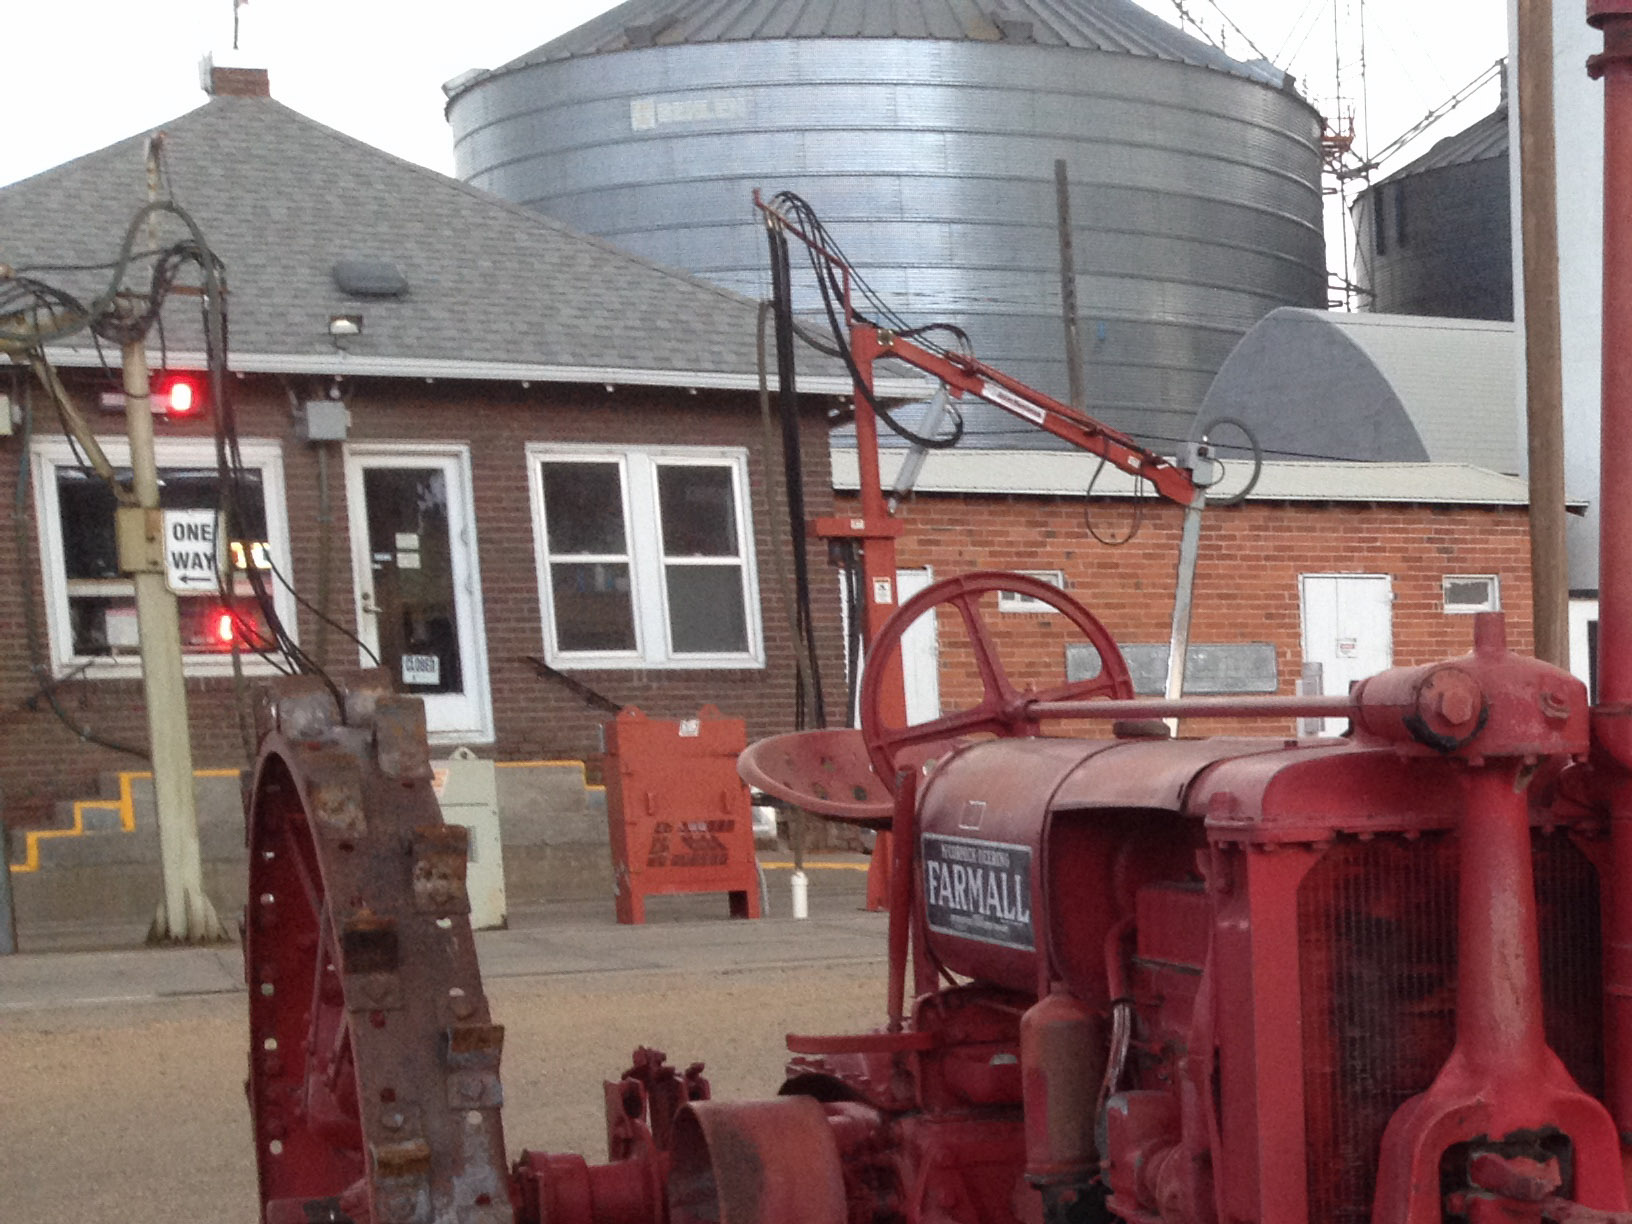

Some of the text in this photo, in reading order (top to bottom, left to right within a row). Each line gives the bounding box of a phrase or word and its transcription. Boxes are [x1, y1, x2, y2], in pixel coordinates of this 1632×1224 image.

[172, 522, 212, 541] ONE
[171, 551, 216, 571] WAY
[927, 860, 1030, 923] FARMALL
